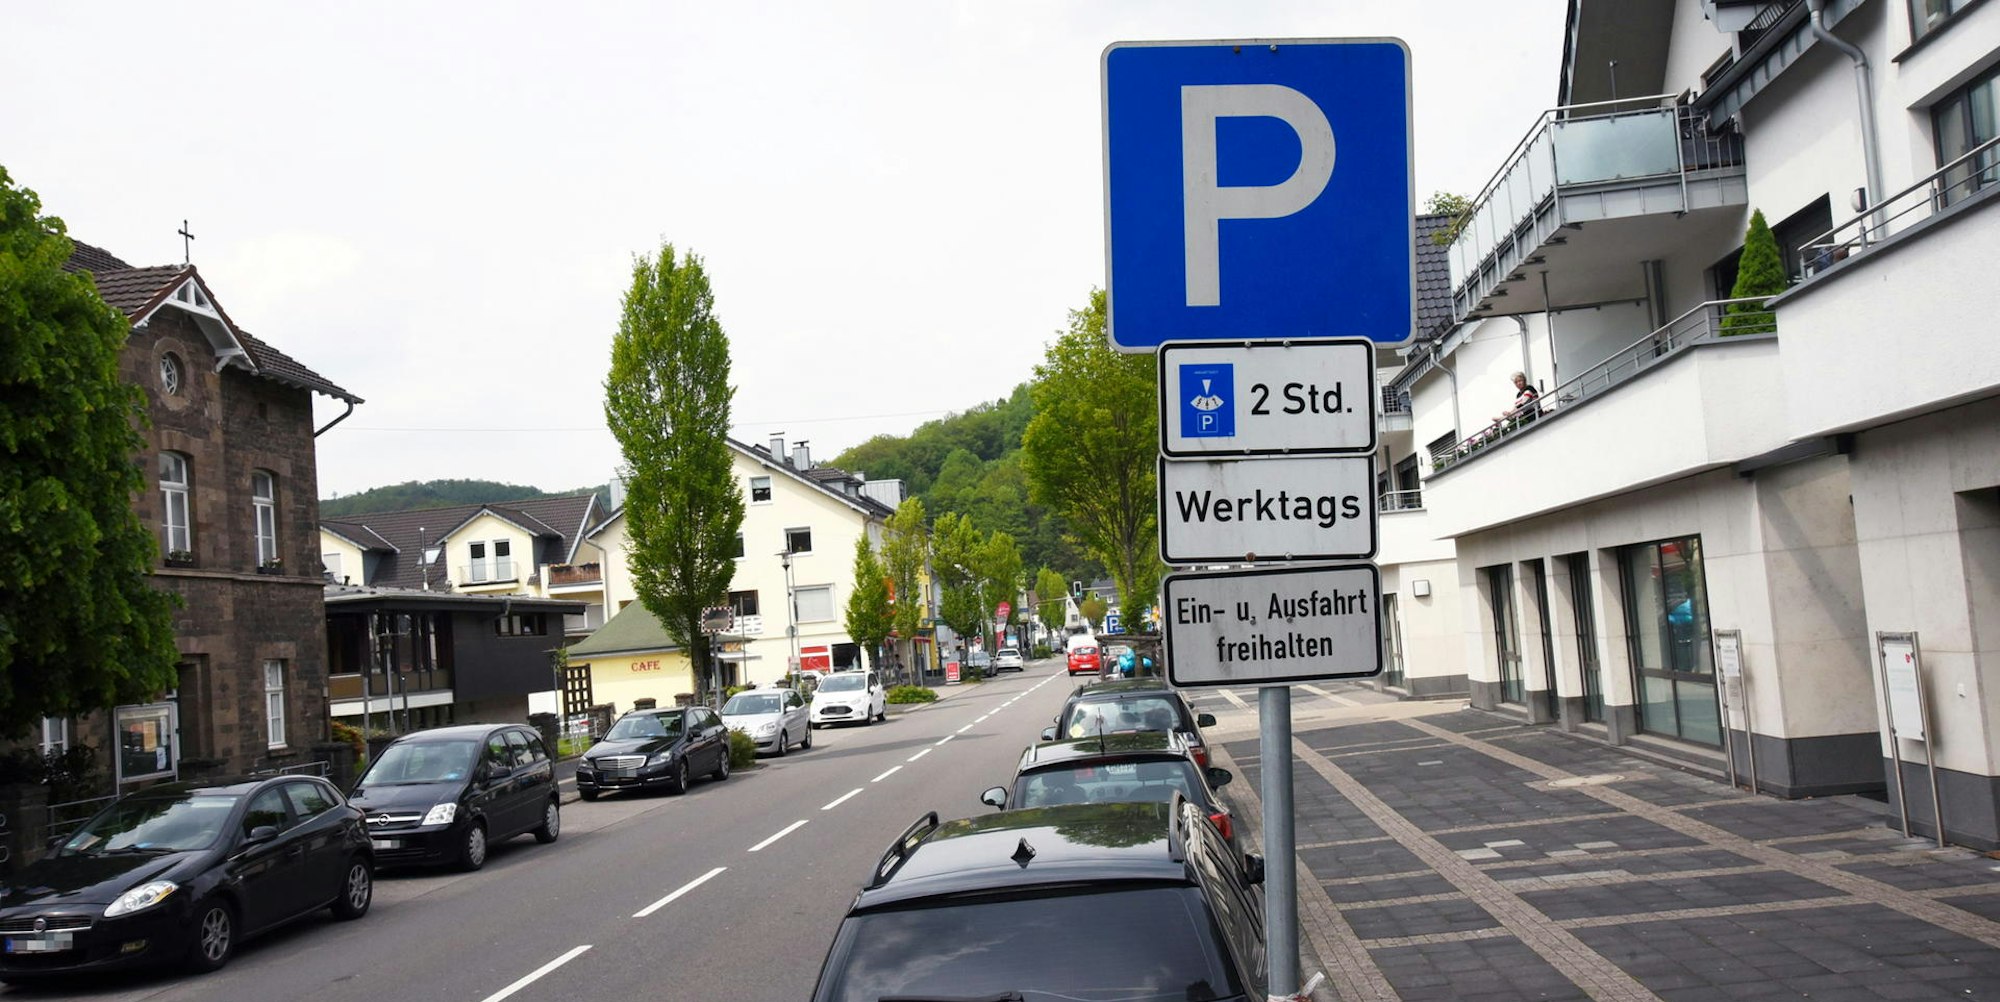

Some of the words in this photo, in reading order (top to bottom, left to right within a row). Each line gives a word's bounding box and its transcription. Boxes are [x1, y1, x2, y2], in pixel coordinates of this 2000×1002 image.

[1181, 84, 1336, 307] P
[1251, 383, 1270, 415] 2
[1283, 381, 1352, 415] Std.
[1202, 415, 1213, 430] P
[1175, 489, 1361, 529] Werktags
[1177, 597, 1225, 625] Ein-
[1268, 589, 1368, 621] Ausfahrt
[1109, 616, 1119, 632] P
[1217, 632, 1334, 662] freihalten
[631, 660, 661, 672] CAFE
